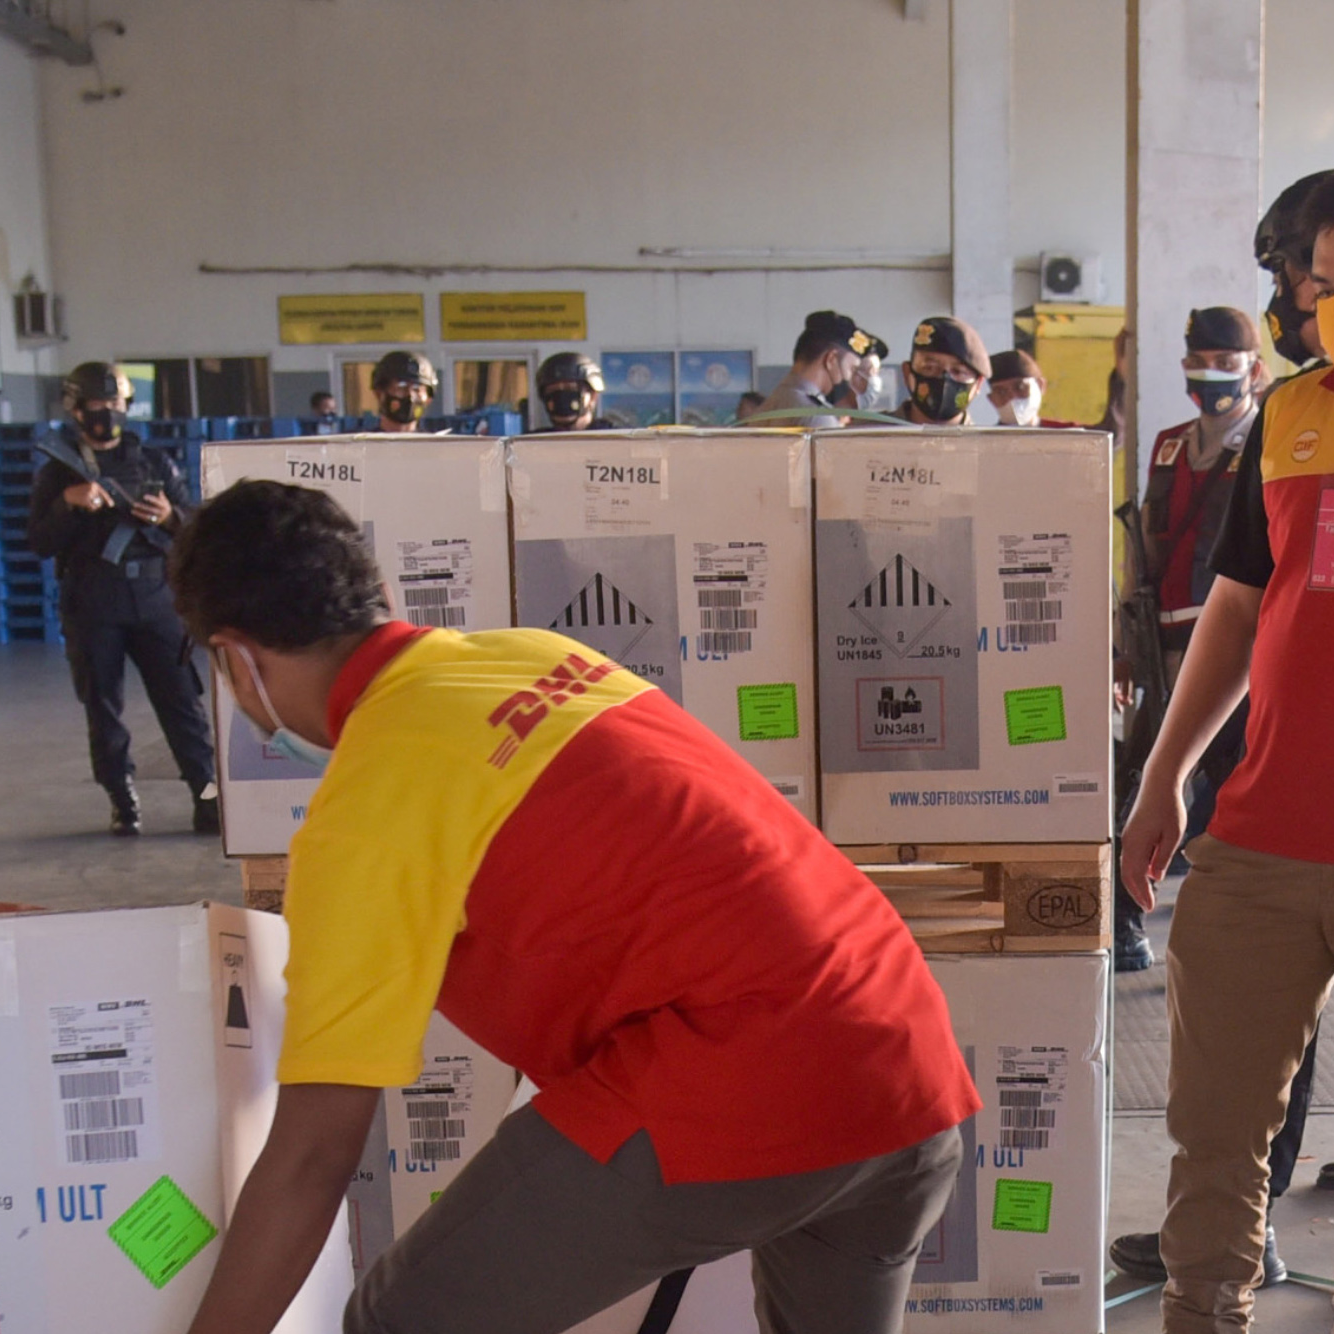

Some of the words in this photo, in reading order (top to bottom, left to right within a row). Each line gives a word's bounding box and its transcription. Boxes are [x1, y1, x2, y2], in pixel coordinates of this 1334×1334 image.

[286, 460, 362, 483] T2N18L
[586, 465, 661, 485] T2N18L
[836, 635, 860, 647] Dry
[860, 635, 878, 646] Ice
[837, 649, 882, 661] UN1845
[487, 652, 615, 744] DHL
[873, 723, 926, 736] UN3481
[889, 789, 1049, 807] WWW.SOFTBOXSYSTEMS.COM
[1038, 895, 1089, 919] EPAL
[58, 1183, 107, 1223] ULT
[905, 1297, 1044, 1314] W.SOFTBOXSYSTEMS.COM
